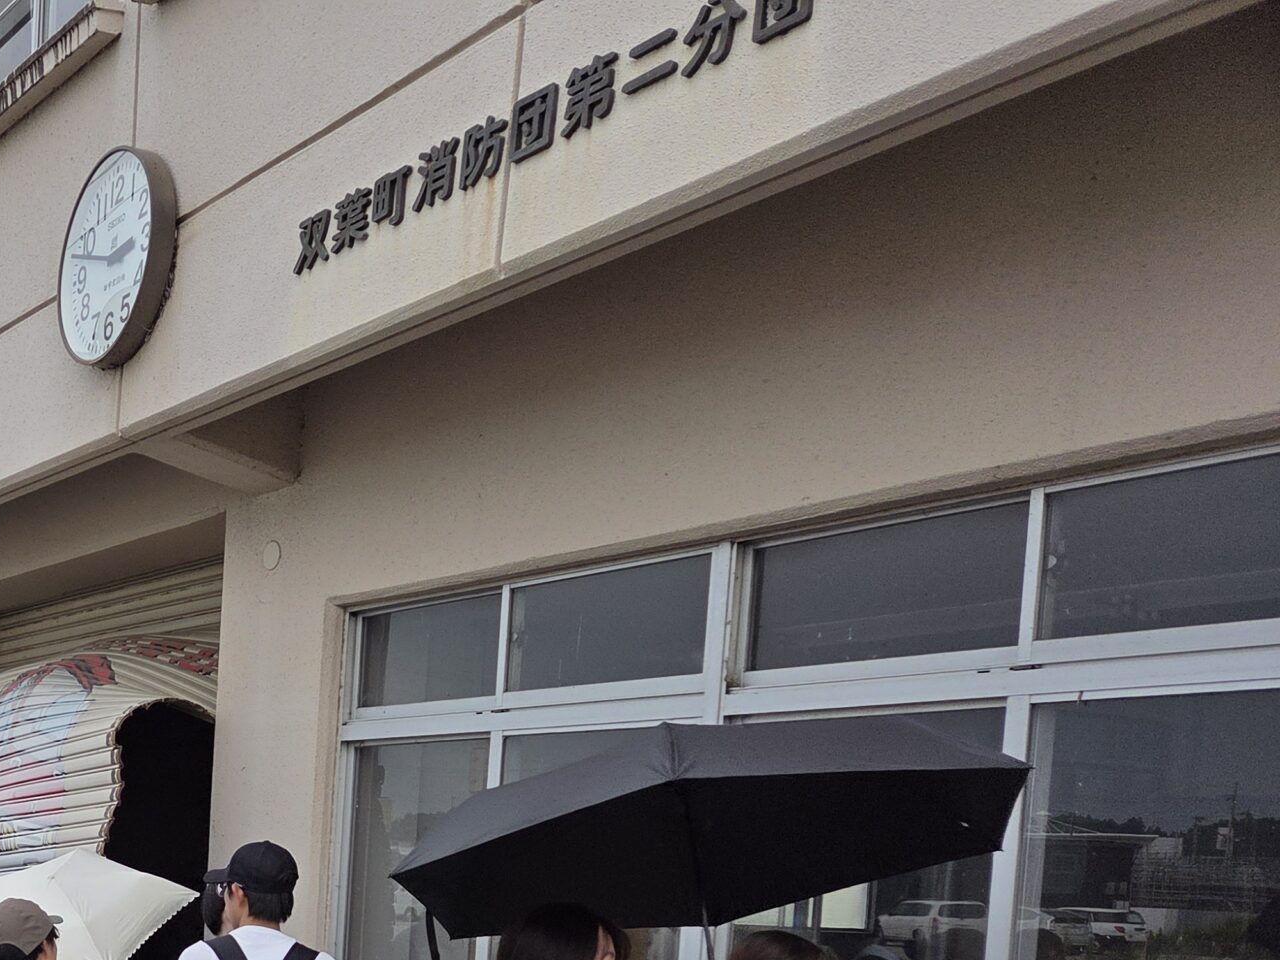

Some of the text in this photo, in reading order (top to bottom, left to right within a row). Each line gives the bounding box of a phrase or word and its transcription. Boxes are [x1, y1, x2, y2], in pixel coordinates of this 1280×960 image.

[110, 175, 125, 209] 12
[137, 188, 149, 220] 2
[96, 193, 108, 226] 11
[82, 227, 96, 256] 10
[140, 221, 151, 253] 3
[77, 265, 88, 295] 9
[132, 259, 144, 287] 4
[80, 293, 91, 322] 8
[120, 292, 131, 324] 5
[91, 311, 101, 342] 7
[103, 311, 114, 342] 6
